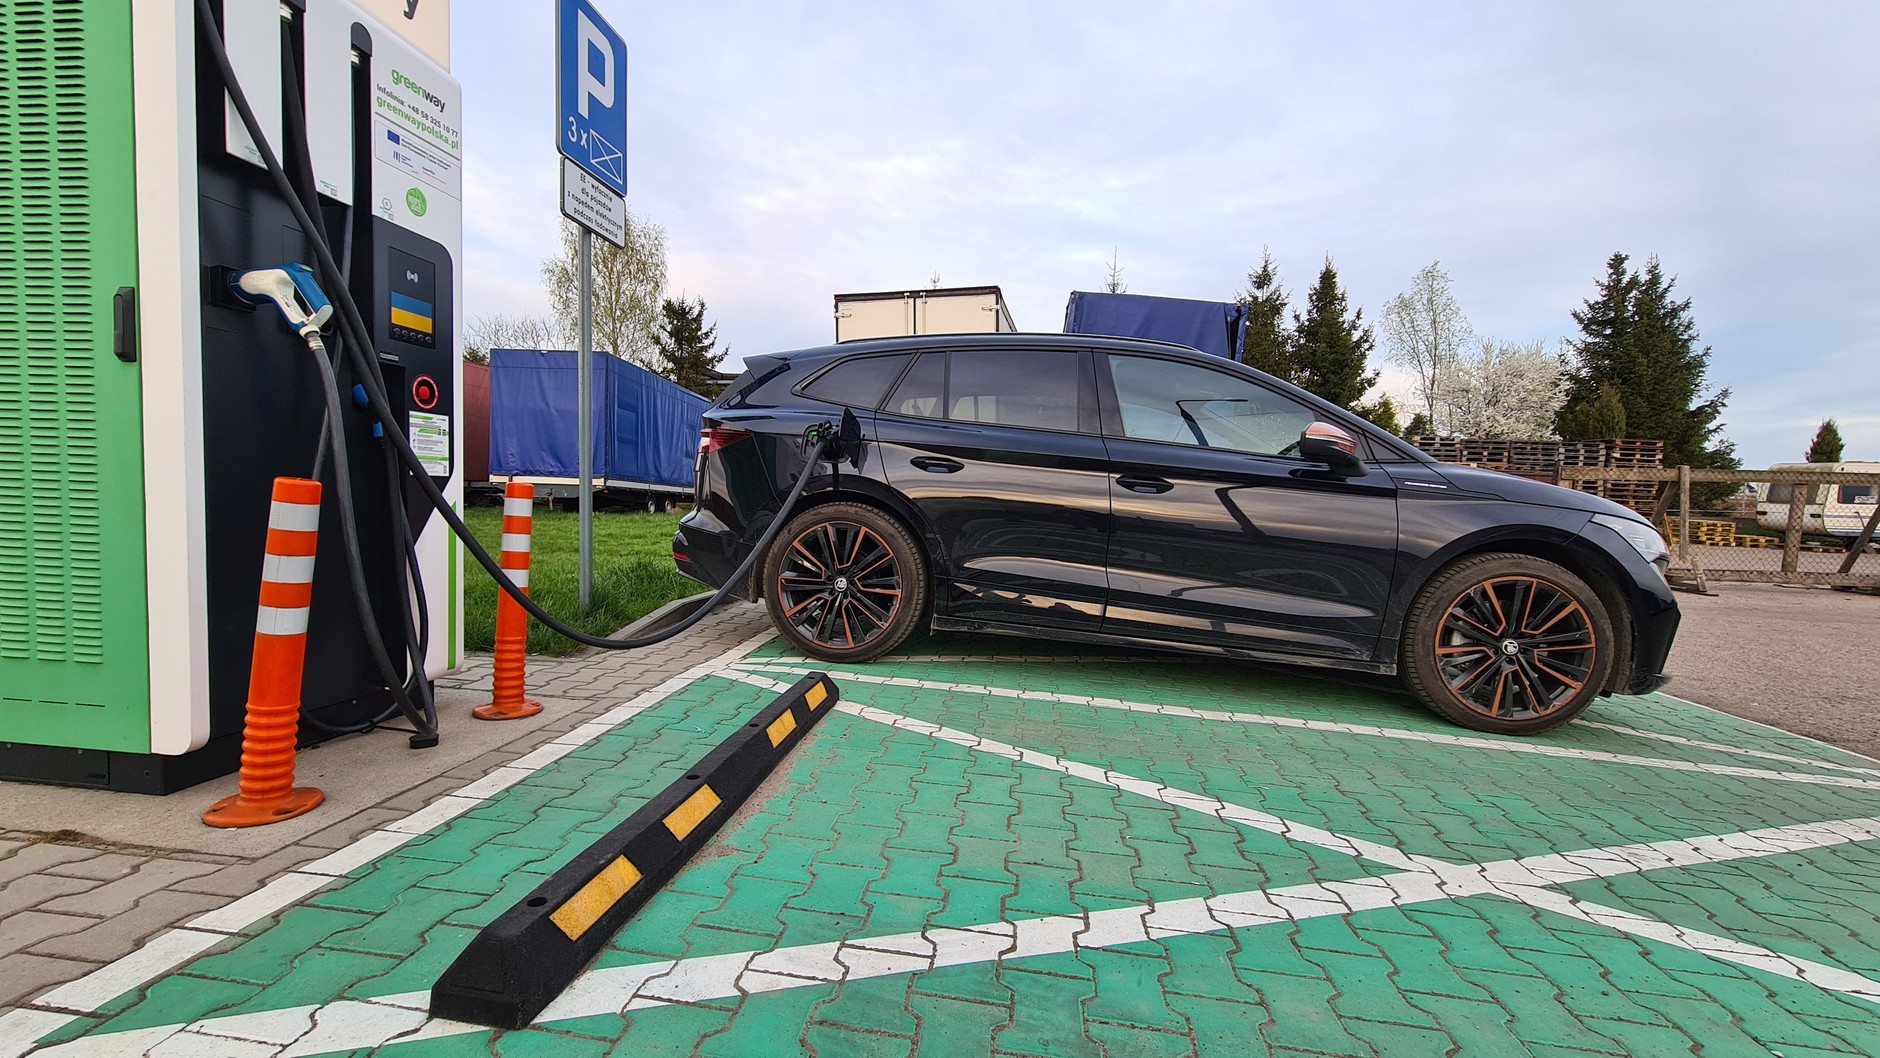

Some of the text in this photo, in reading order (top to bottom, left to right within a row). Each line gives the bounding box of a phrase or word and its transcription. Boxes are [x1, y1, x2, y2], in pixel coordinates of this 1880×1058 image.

[578, 8, 615, 120] P
[391, 69, 445, 113] greenway
[377, 96, 459, 150] greenwaypolska.pl
[408, 104, 420, 115] +48
[421, 110, 429, 121] 58
[430, 116, 442, 129] 325
[443, 124, 451, 134] 10
[451, 129, 459, 138] 77
[568, 116, 588, 150] 3 x
[567, 190, 571, 198] z
[581, 187, 589, 198] dla
[573, 207, 593, 223] podczas
